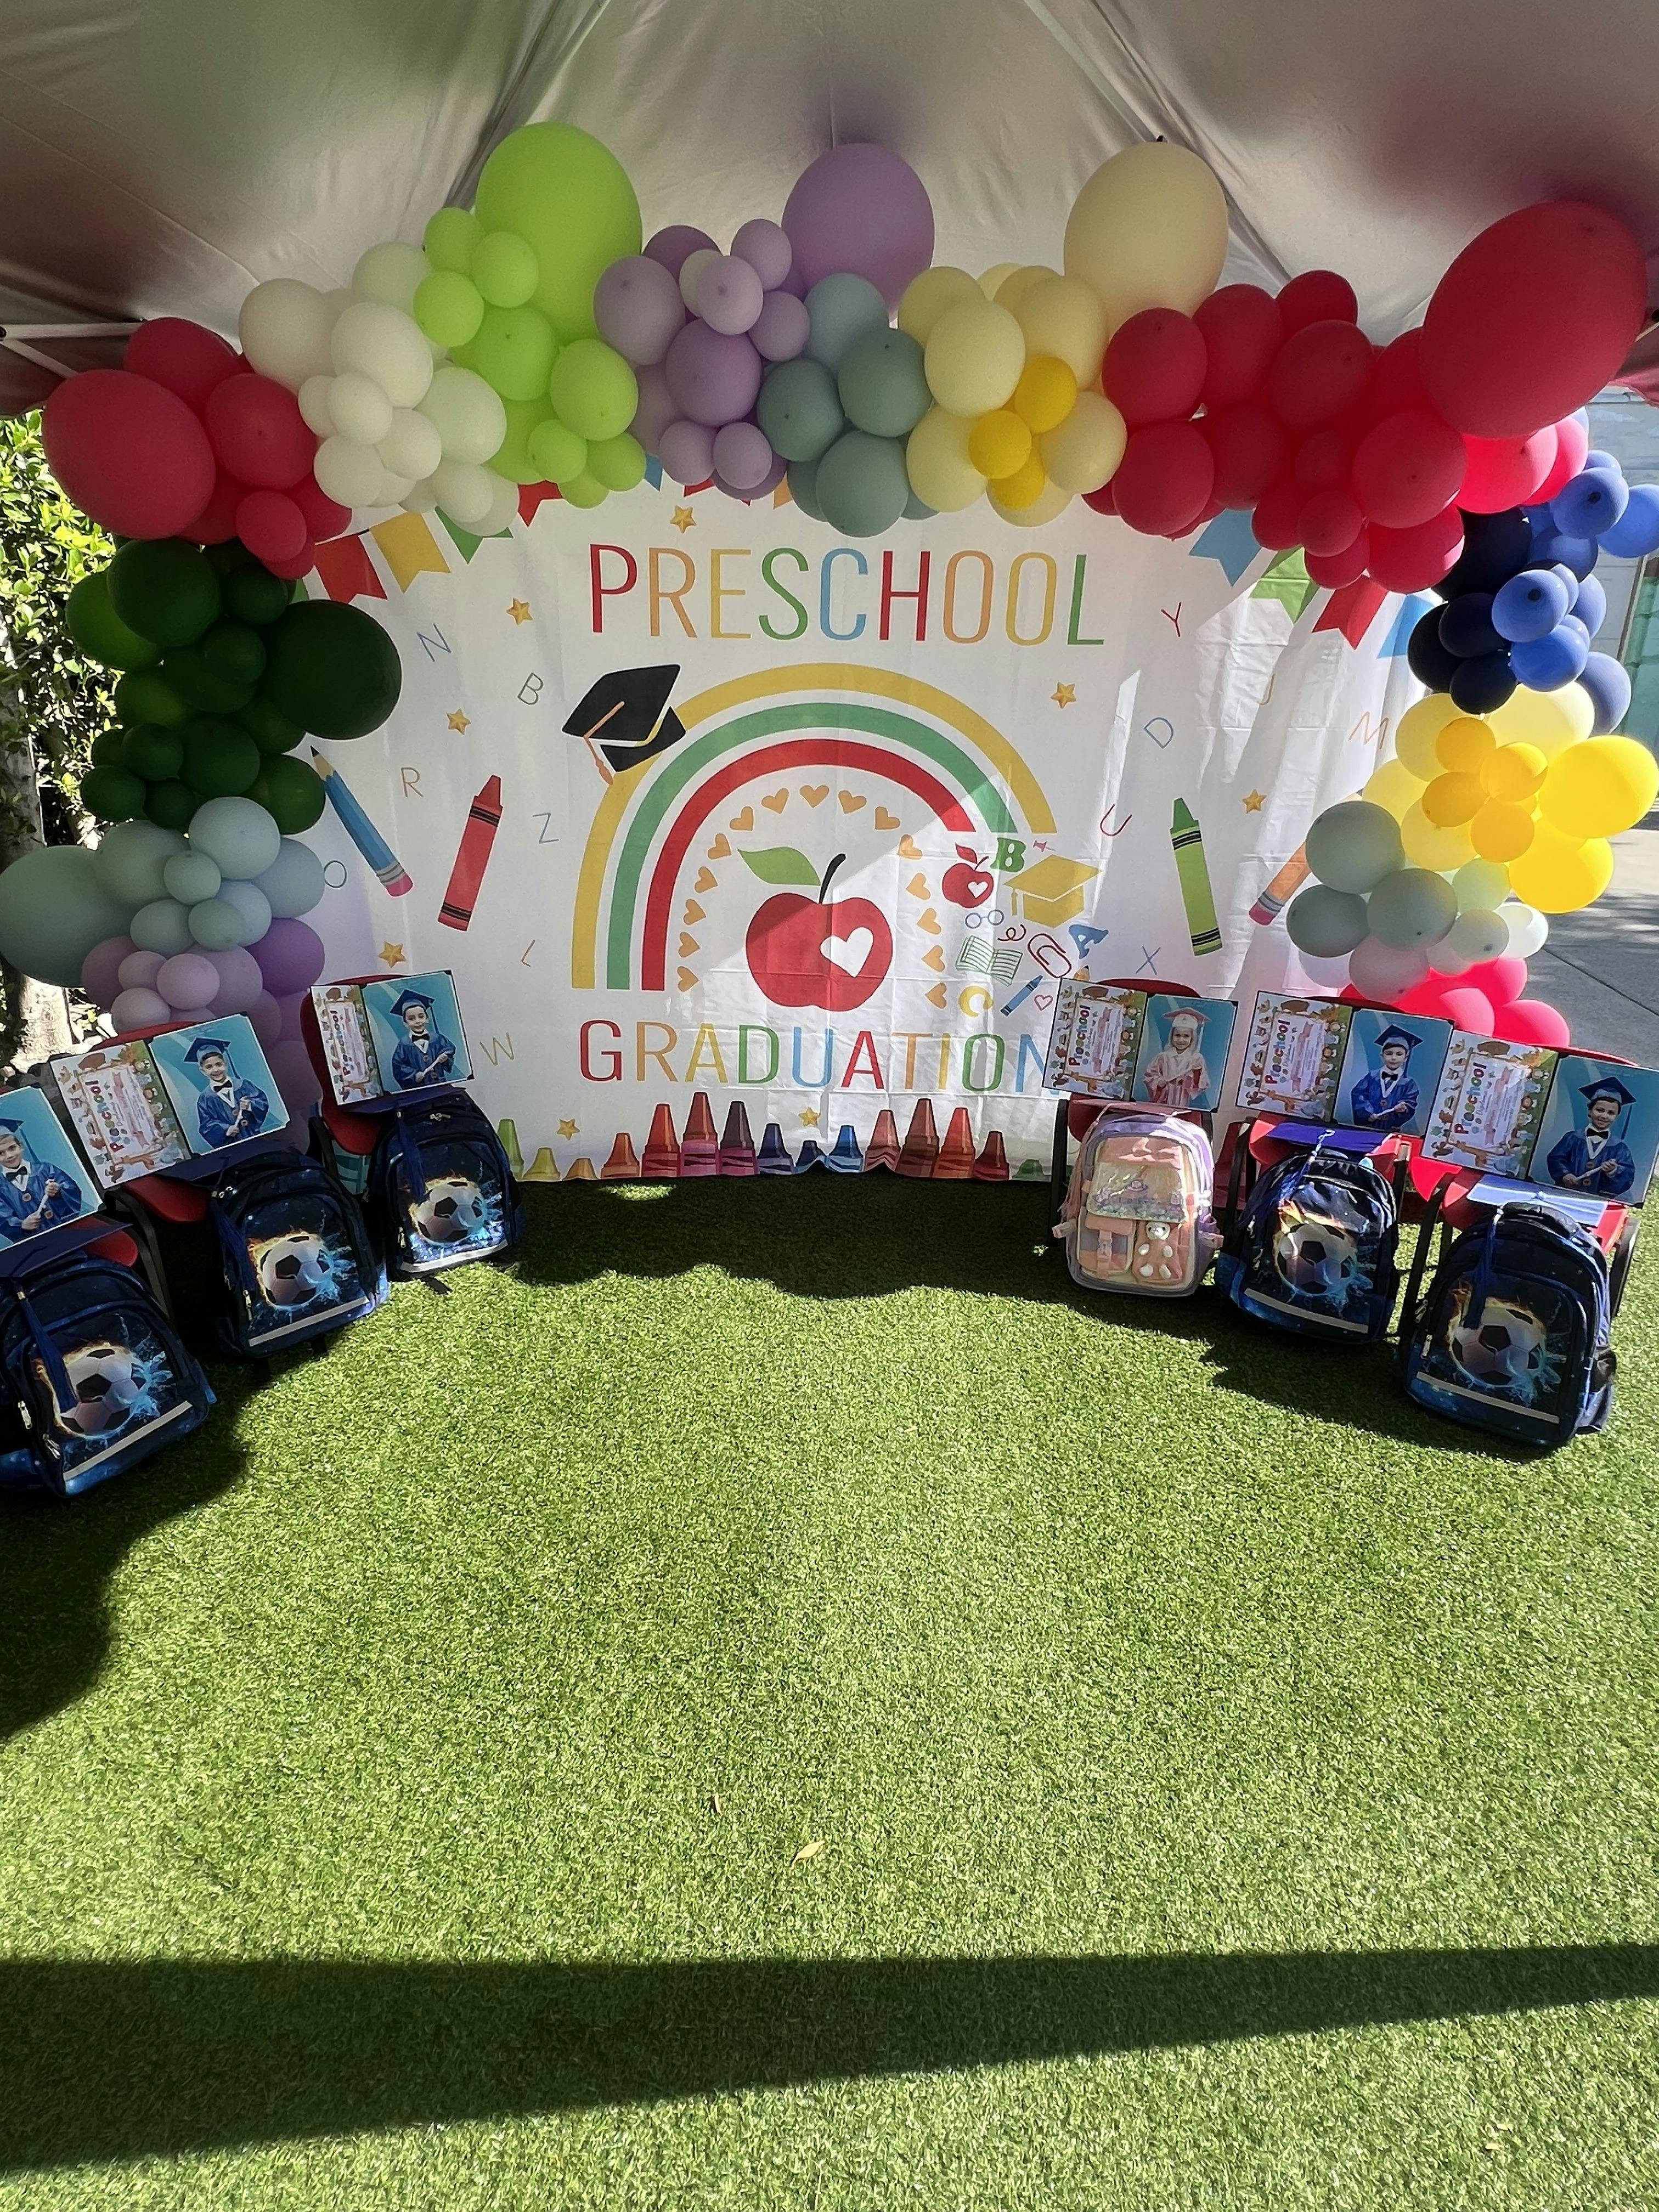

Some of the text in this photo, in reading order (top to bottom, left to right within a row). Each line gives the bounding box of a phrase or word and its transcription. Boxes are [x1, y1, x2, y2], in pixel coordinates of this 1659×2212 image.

[589, 543, 1105, 646] PRESCHOOL
[1160, 601, 1182, 637] Y
[416, 623, 452, 662] N
[517, 673, 544, 706] B
[1143, 716, 1175, 748] D
[1347, 711, 1390, 750] M
[400, 767, 424, 798] R
[532, 812, 560, 844] Z
[1099, 803, 1133, 837] U
[990, 837, 1026, 872] B
[323, 860, 347, 889] O
[521, 939, 536, 968] L
[1068, 924, 1109, 959] A
[1135, 945, 1161, 975] X
[958, 985, 994, 1018] C
[479, 1031, 515, 1066] W
